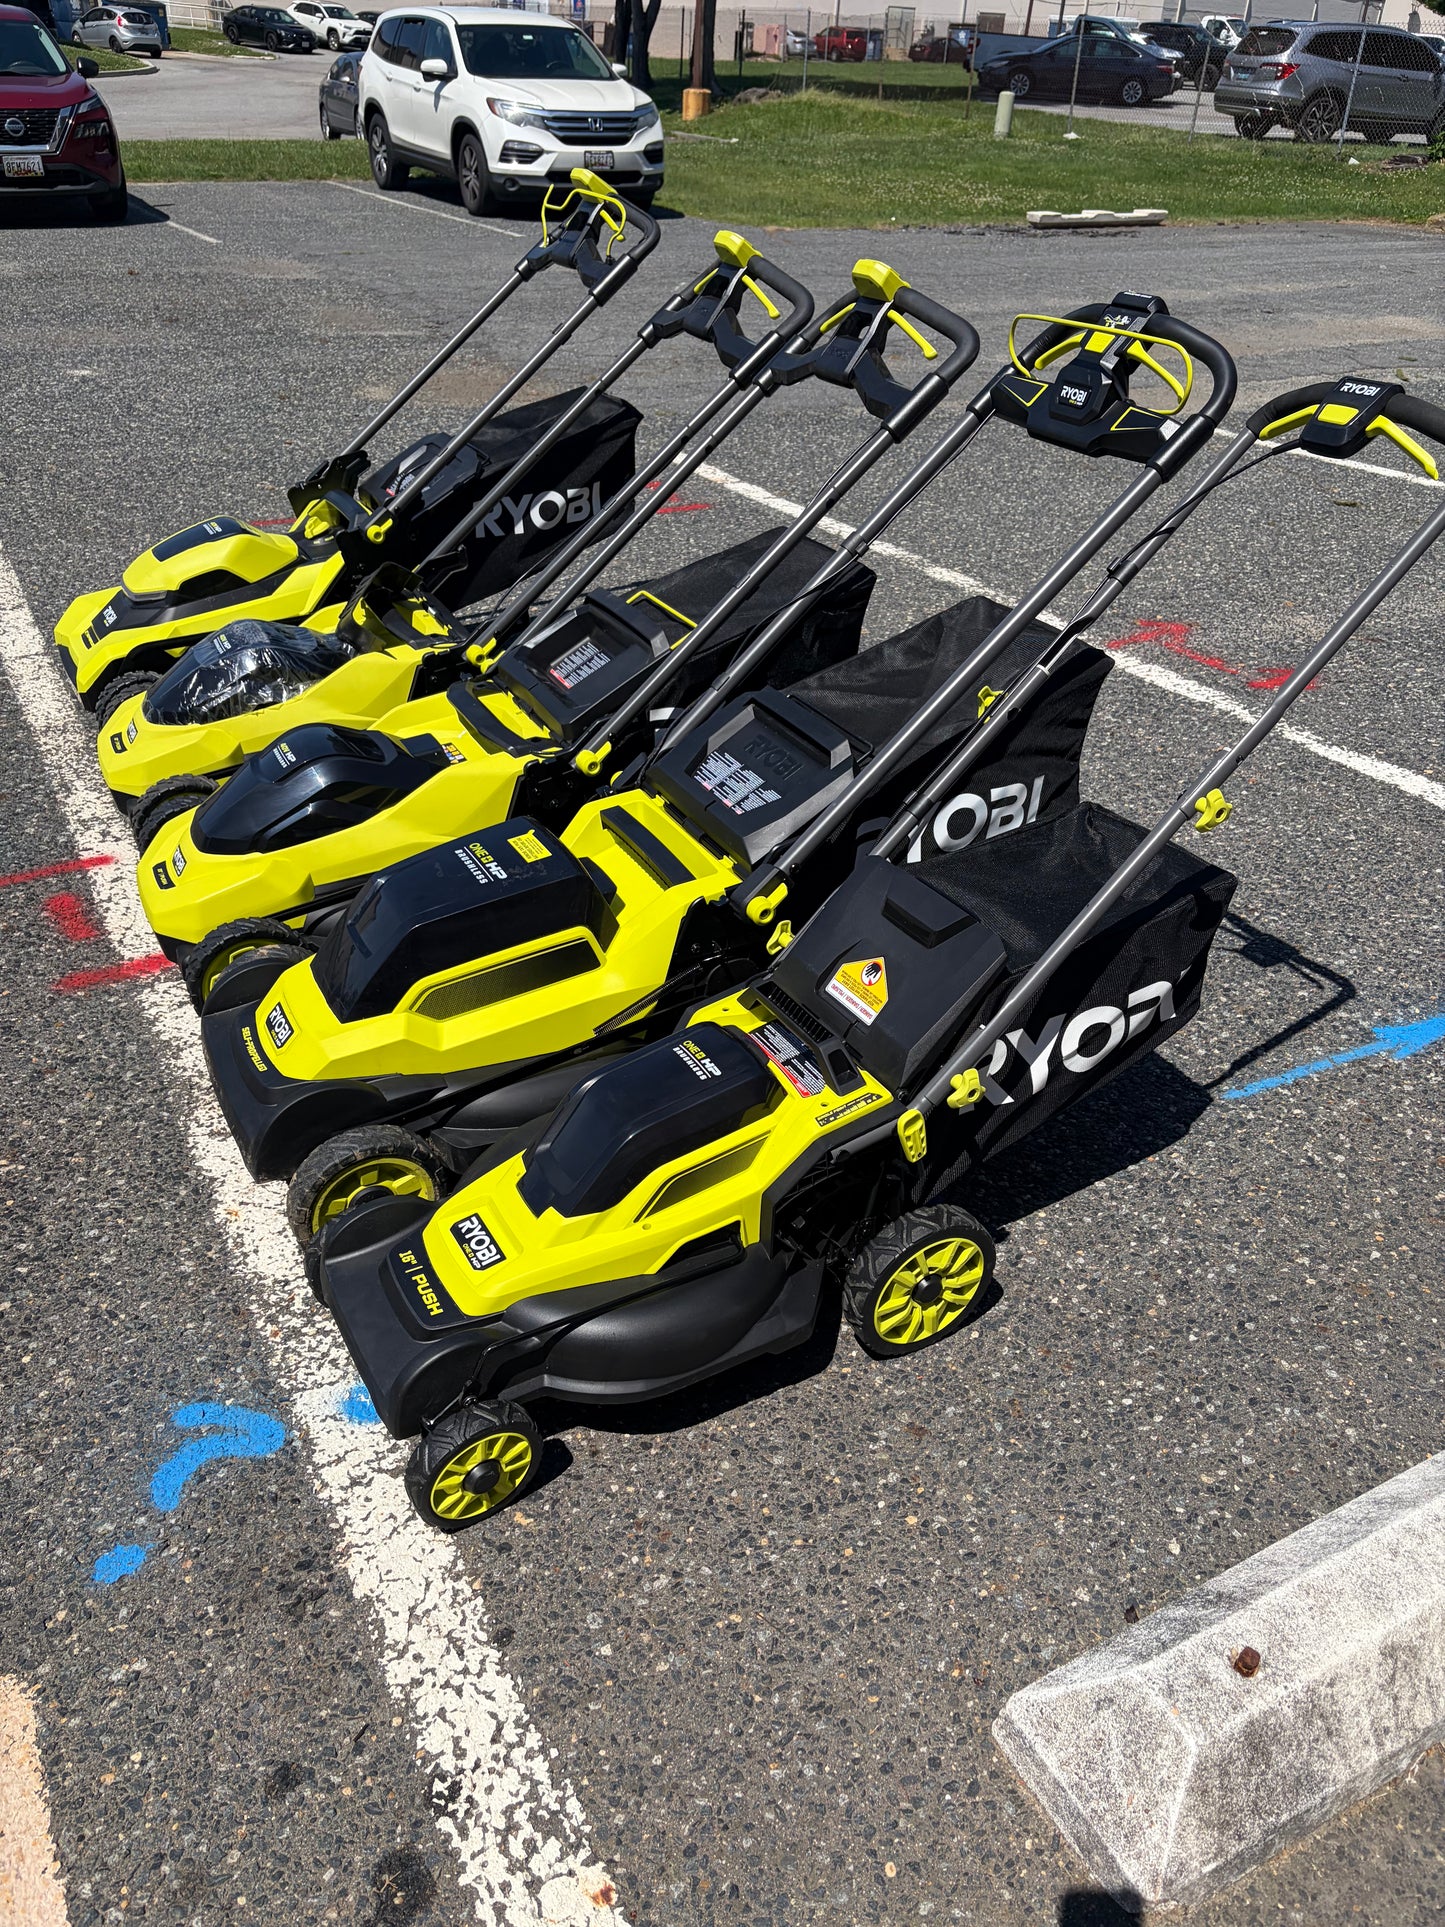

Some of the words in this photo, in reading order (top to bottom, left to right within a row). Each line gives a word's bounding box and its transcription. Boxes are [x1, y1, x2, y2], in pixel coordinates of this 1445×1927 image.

[1060, 385, 1088, 403] RYOBI
[1340, 382, 1381, 397] RYOBI
[285, 751, 297, 762] HP
[907, 775, 1045, 864] YOBI
[454, 849, 489, 884] BRUSHLESS
[485, 861, 508, 880] HP
[269, 1005, 292, 1044] RYOBI
[241, 1026, 268, 1072] SELF-PROPELLED
[672, 1046, 708, 1080] BRUSHLESS
[700, 1057, 722, 1076] HP
[458, 1216, 501, 1267] RYOBI
[470, 1257, 481, 1269] HP
[398, 1250, 418, 1265] 16"
[411, 1273, 444, 1317] PUSH
